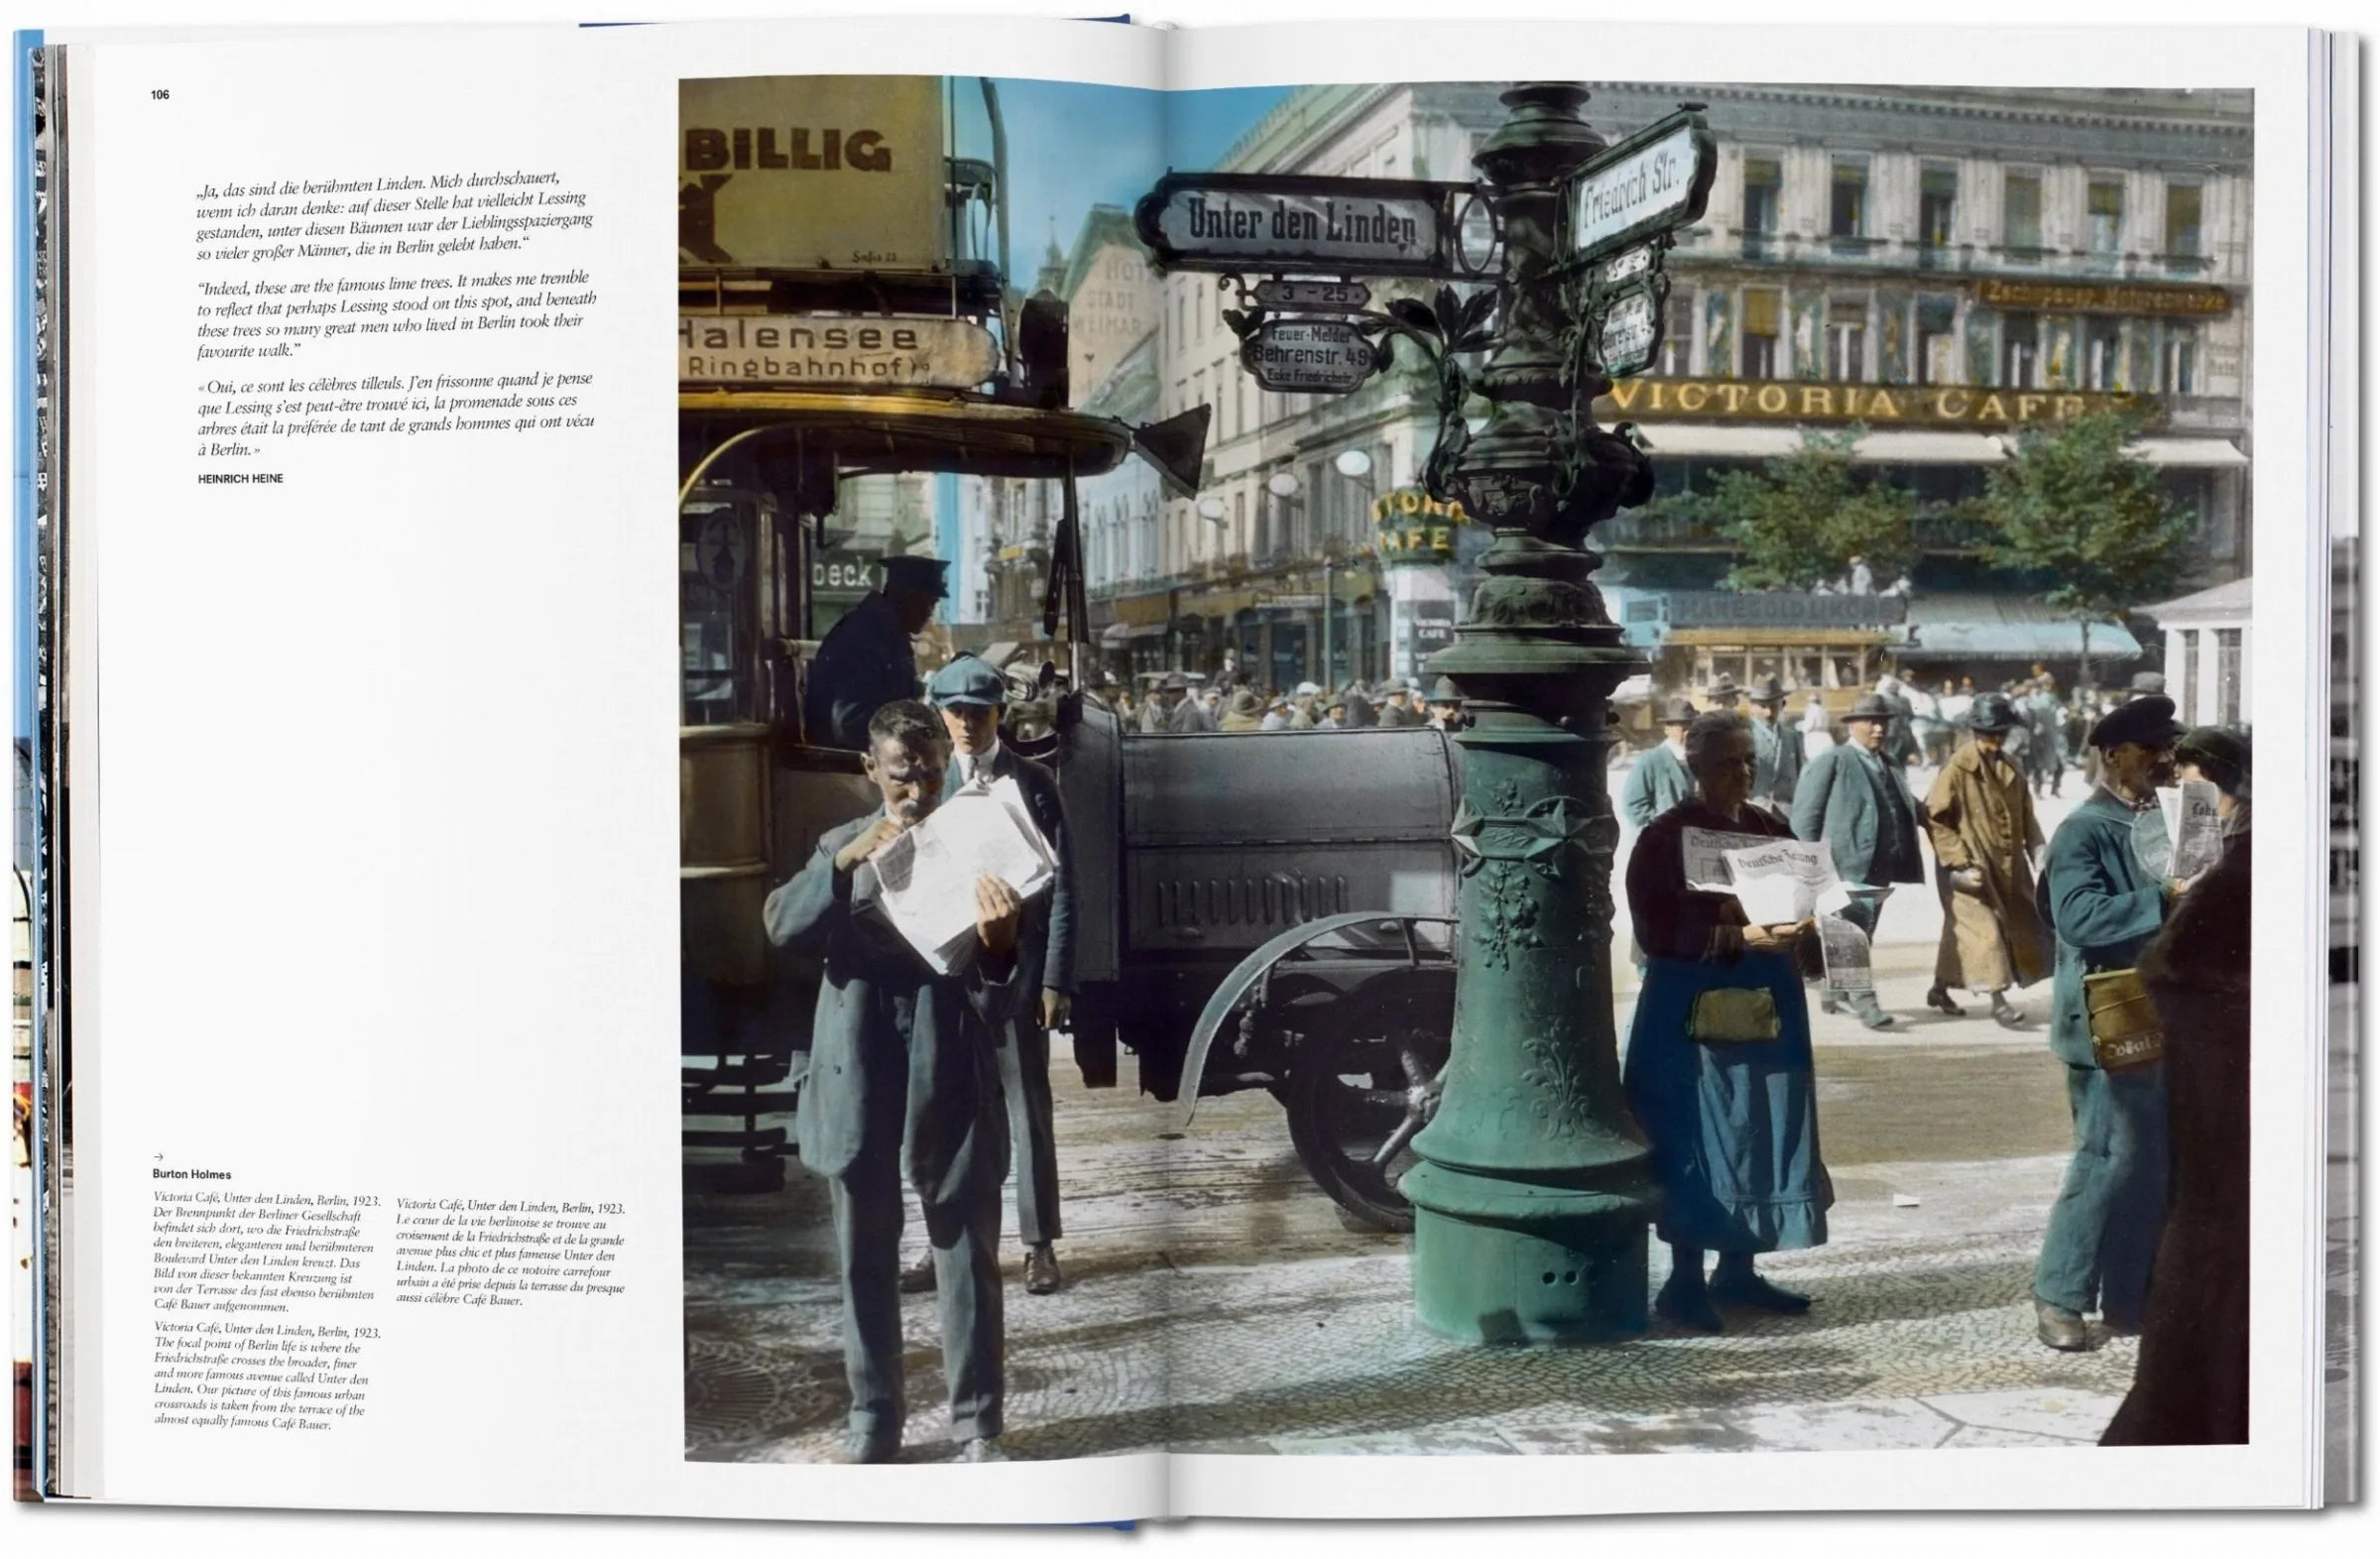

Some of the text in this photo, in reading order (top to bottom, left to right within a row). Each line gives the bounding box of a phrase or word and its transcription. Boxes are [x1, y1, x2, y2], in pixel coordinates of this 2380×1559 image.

[150, 88, 171, 101] 106
[685, 127, 892, 172] BILLIG
[222, 181, 246, 198] das
[248, 180, 278, 196] sind
[279, 180, 300, 195] die
[302, 178, 374, 195] berühmten
[376, 175, 426, 191] Linden.
[429, 173, 464, 189] Mich
[466, 170, 560, 188] durchschauert,
[1584, 150, 1680, 229] Friedrich Str.
[195, 207, 233, 219] wenn
[236, 202, 257, 218] ich
[259, 201, 298, 217] daran
[347, 197, 373, 217] auf
[373, 197, 412, 213] dieser
[414, 195, 449, 211] Stelle
[451, 193, 474, 210] hat
[477, 190, 535, 208] vielleicht
[537, 190, 587, 208] Lessing
[195, 212, 594, 244] gestanden, unter diesen Bäumen war der Lieblingsspaziergang
[1189, 197, 1417, 246] Unter den Linden
[195, 250, 212, 261] so
[215, 245, 251, 260] vieler
[251, 243, 296, 264] großer
[297, 243, 352, 258] Männer,
[355, 240, 376, 256] die
[378, 241, 393, 255] in
[396, 238, 434, 255] Berlin
[436, 236, 476, 257] gelebt
[254, 280, 288, 296] these
[290, 283, 311, 295] are
[313, 277, 334, 294] the
[336, 277, 386, 296] famous
[388, 276, 417, 291] lime
[419, 277, 453, 290] trees.
[456, 274, 468, 288] It
[470, 271, 513, 288] makes
[515, 275, 537, 286] me
[539, 268, 590, 286] tremble
[196, 290, 598, 319] to reflect that perhaps Lessing stood on this spot, and beneath
[1252, 344, 1368, 366] Behrenstr. 49
[1266, 368, 1290, 383] Ecke
[197, 404, 223, 419] que
[224, 400, 274, 418] Lessing
[304, 398, 363, 417] peut-être
[365, 396, 409, 412] trouvé
[411, 396, 430, 413] ici,
[433, 395, 446, 410] la
[448, 392, 524, 414] promenade
[526, 396, 555, 408] sous
[557, 396, 578, 407] ces
[1611, 377, 1900, 417] VICTORIA
[197, 413, 595, 437] arbres était la préférée de tant de grands hommes qui ont vécu
[197, 472, 285, 485] HEINRICH HEINE
[152, 1167, 232, 1180] Burton Holmes
[154, 1190, 382, 1208] Victoria Café, Unter den Linden, Berlin, 1923.
[397, 1197, 626, 1216] Victoria Café, Unter den Linden, Berlin, 1923.
[153, 1206, 362, 1224] Der Brennpunkt der Berliner Gesellschaft
[396, 1213, 607, 1230] Le cœur de la vie berlinoise se trouve au
[154, 1320, 382, 1340] Victoria Café, Unter den Linden, Berlin, 1923.
[154, 1336, 362, 1355] The focal point of Berlin life is where the
